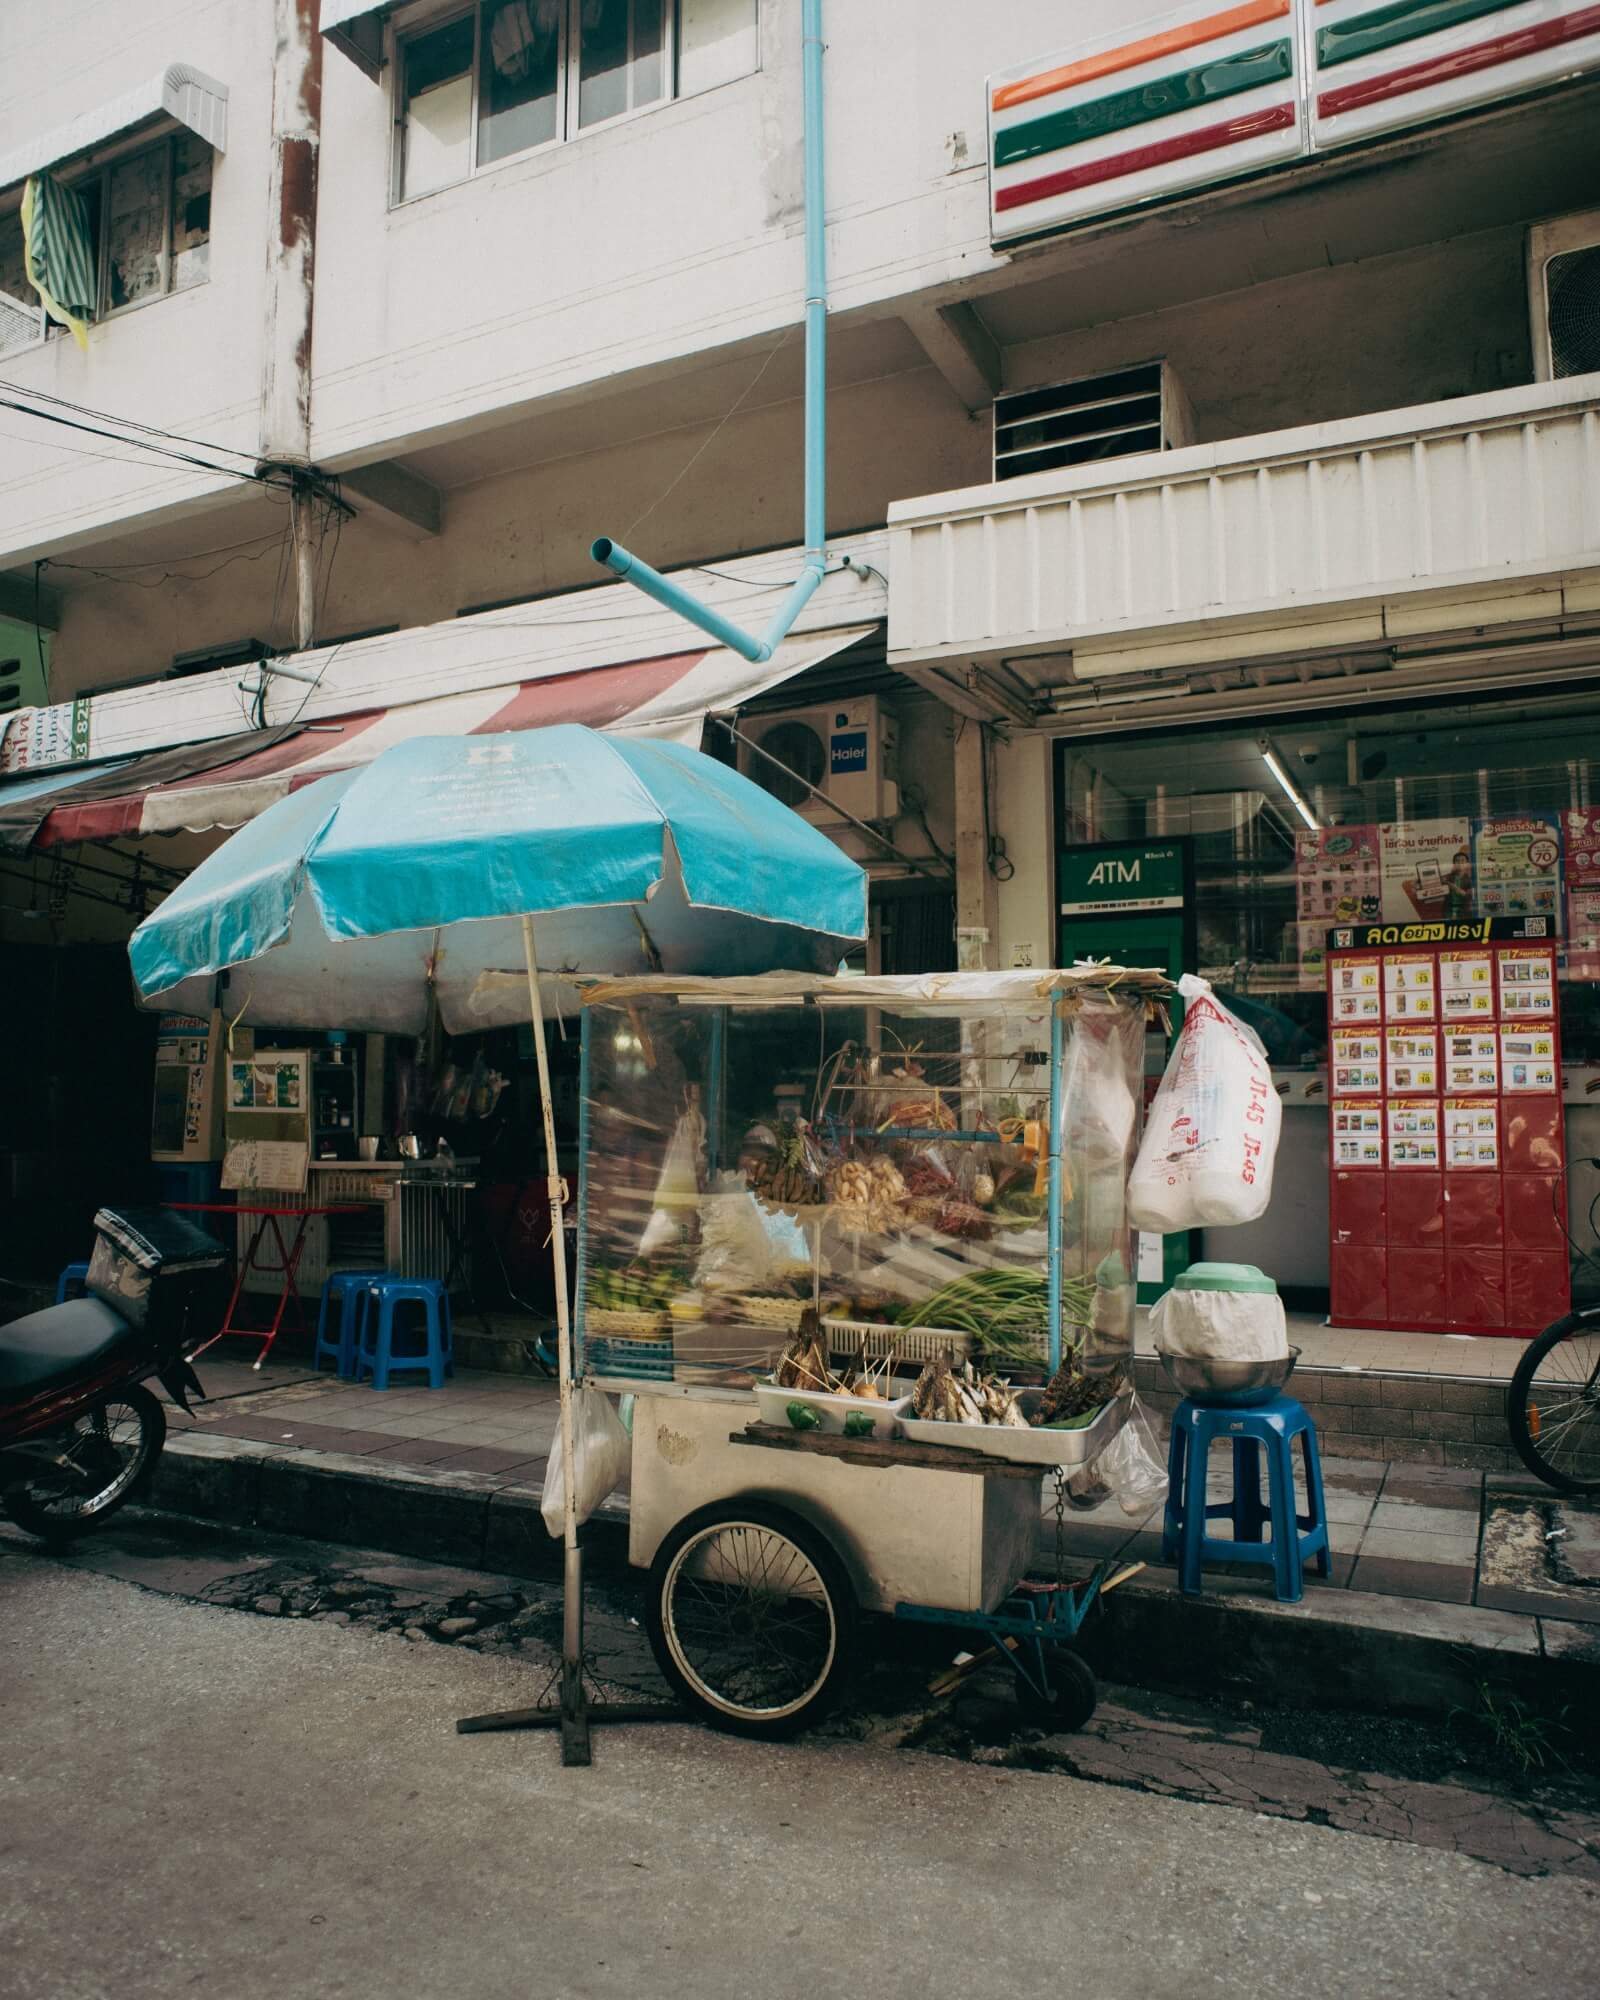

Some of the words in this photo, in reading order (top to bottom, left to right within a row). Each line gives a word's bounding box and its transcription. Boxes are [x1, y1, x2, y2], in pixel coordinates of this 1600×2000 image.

[831, 746, 866, 761] Haier
[1536, 852, 1552, 863] 70
[1087, 859, 1141, 885] ATM
[1245, 1075, 1268, 1125] JT-45
[1242, 1133, 1263, 1185] JT-45
